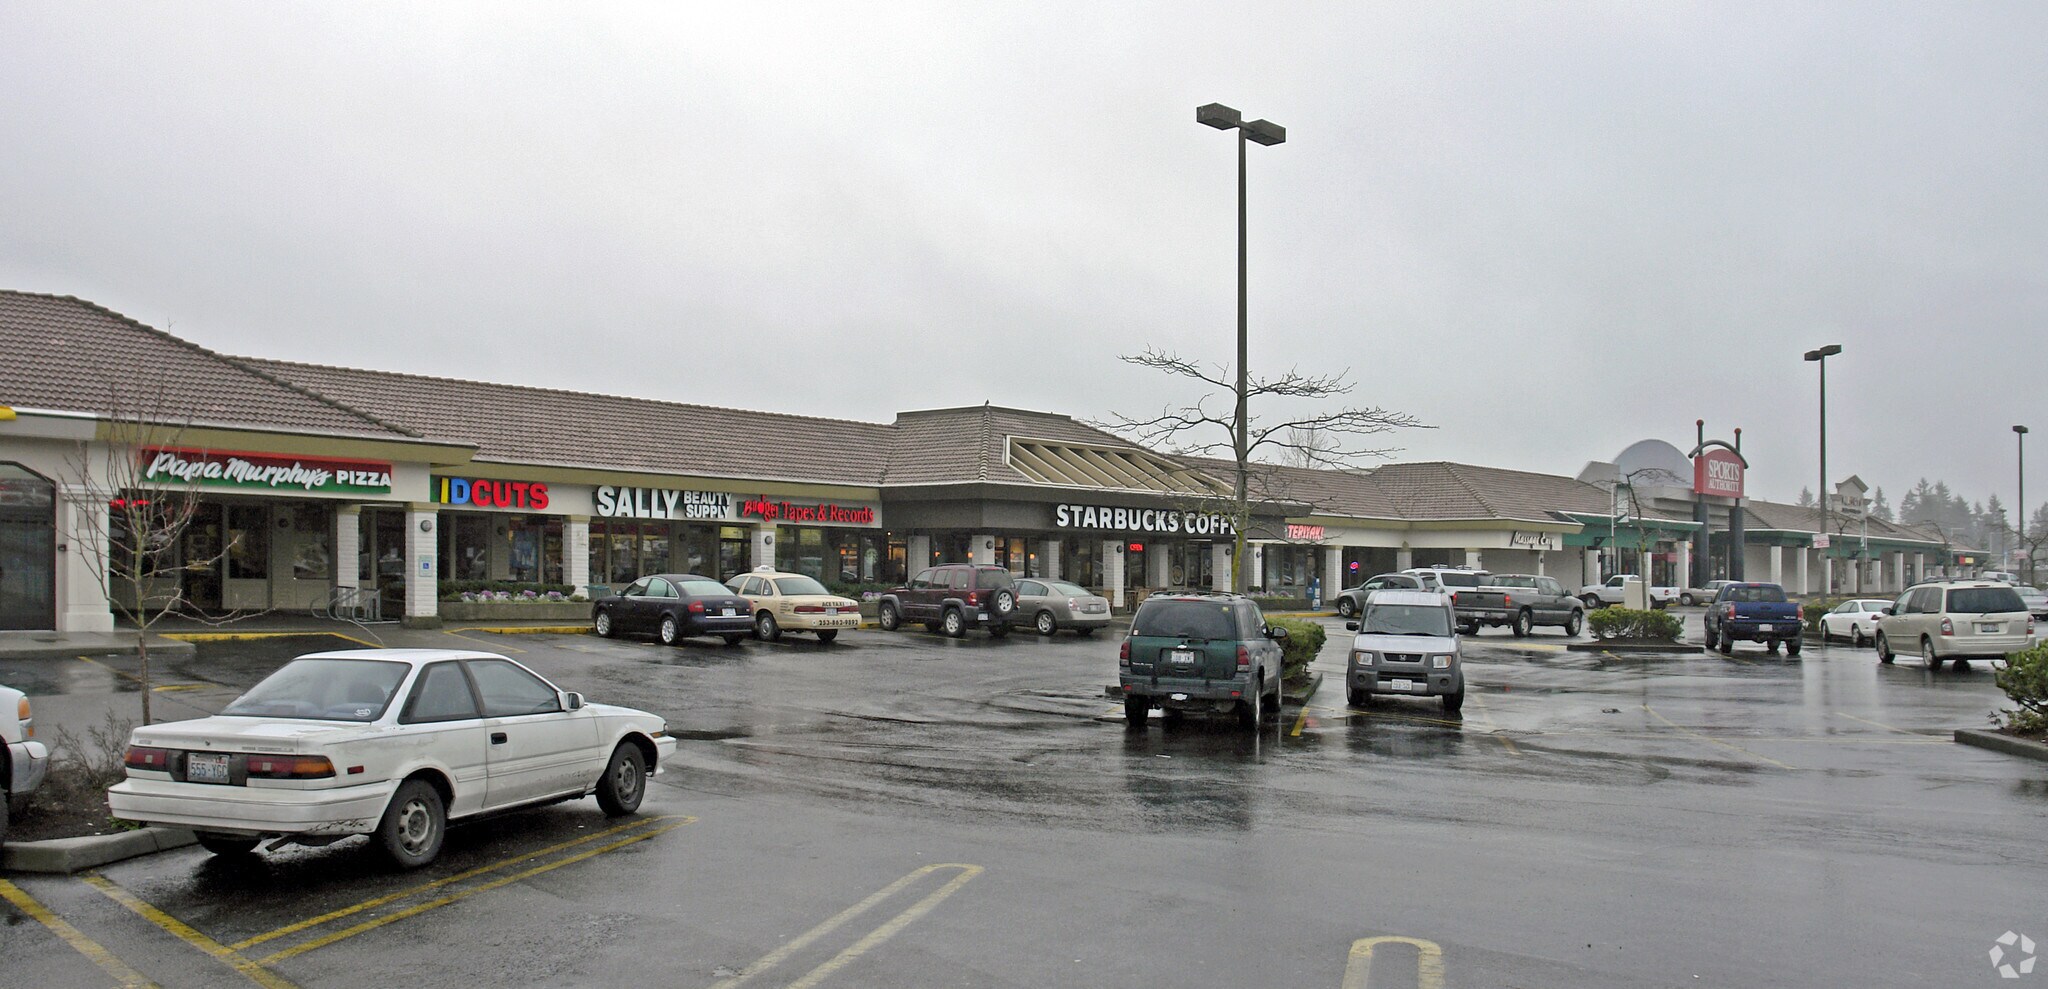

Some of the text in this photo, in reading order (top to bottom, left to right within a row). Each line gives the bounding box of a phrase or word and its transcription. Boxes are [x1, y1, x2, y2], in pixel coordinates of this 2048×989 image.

[146, 452, 391, 490] Papa Murphy's PIZZA
[1708, 459, 1740, 481] SPORTS
[1708, 478, 1740, 492] AUTHORITY
[597, 485, 680, 519] SALLY
[683, 490, 732, 506] BEAUTY
[685, 504, 731, 519] SUPPLY
[781, 501, 814, 523] Tapes
[817, 503, 827, 521] &
[830, 503, 874, 523] Records
[1056, 504, 1179, 533] STARBUCKS
